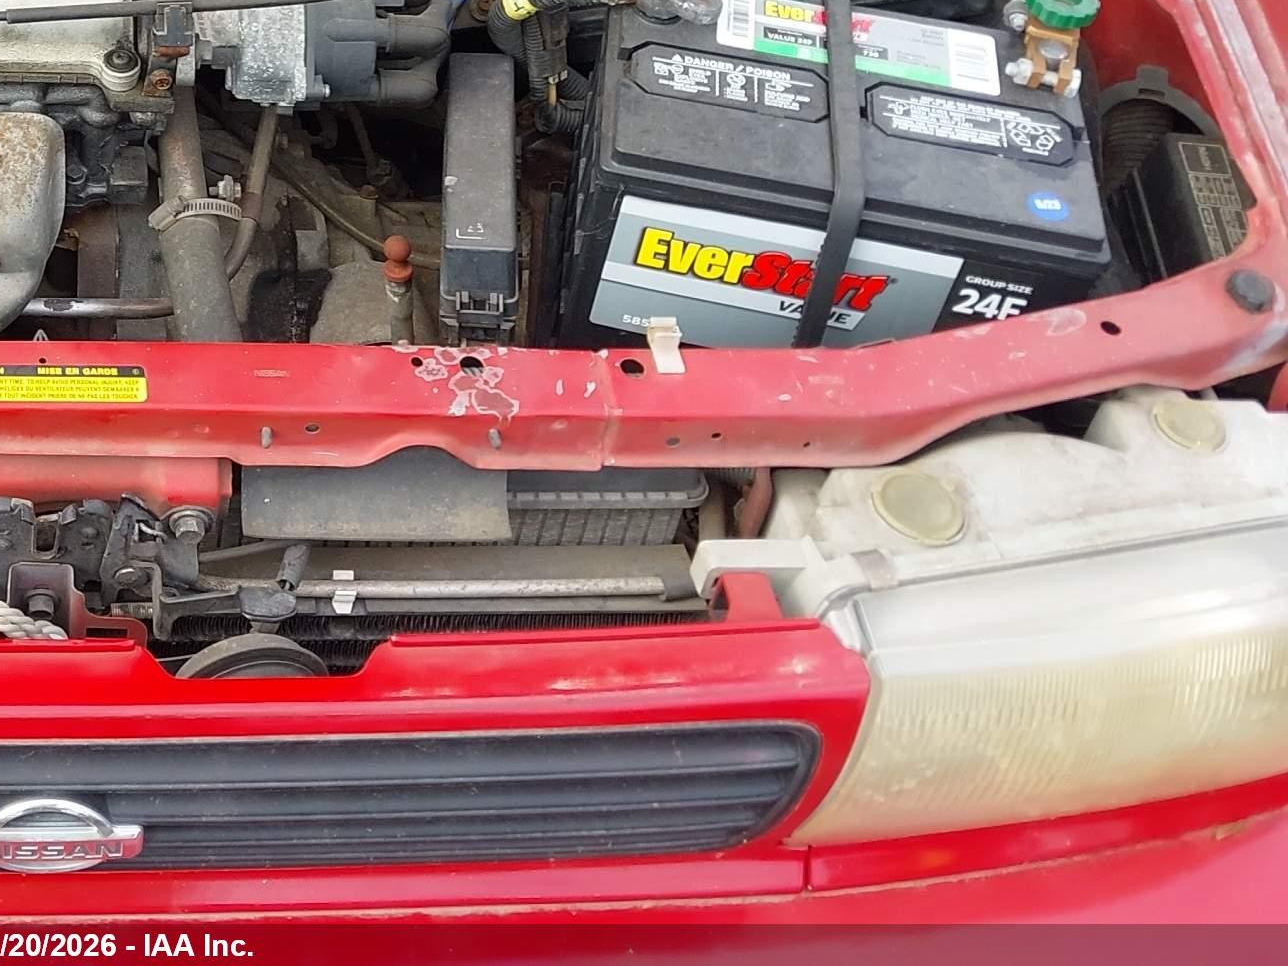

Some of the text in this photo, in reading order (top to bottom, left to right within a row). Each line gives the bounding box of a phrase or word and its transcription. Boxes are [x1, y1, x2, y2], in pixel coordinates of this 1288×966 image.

[684, 56, 734, 72] DANGER
[746, 65, 791, 81] POISON
[965, 274, 1033, 295] GROUP SIZE
[37, 367, 63, 375] MISE
[65, 367, 80, 375] EN
[82, 367, 118, 376] GARDE
